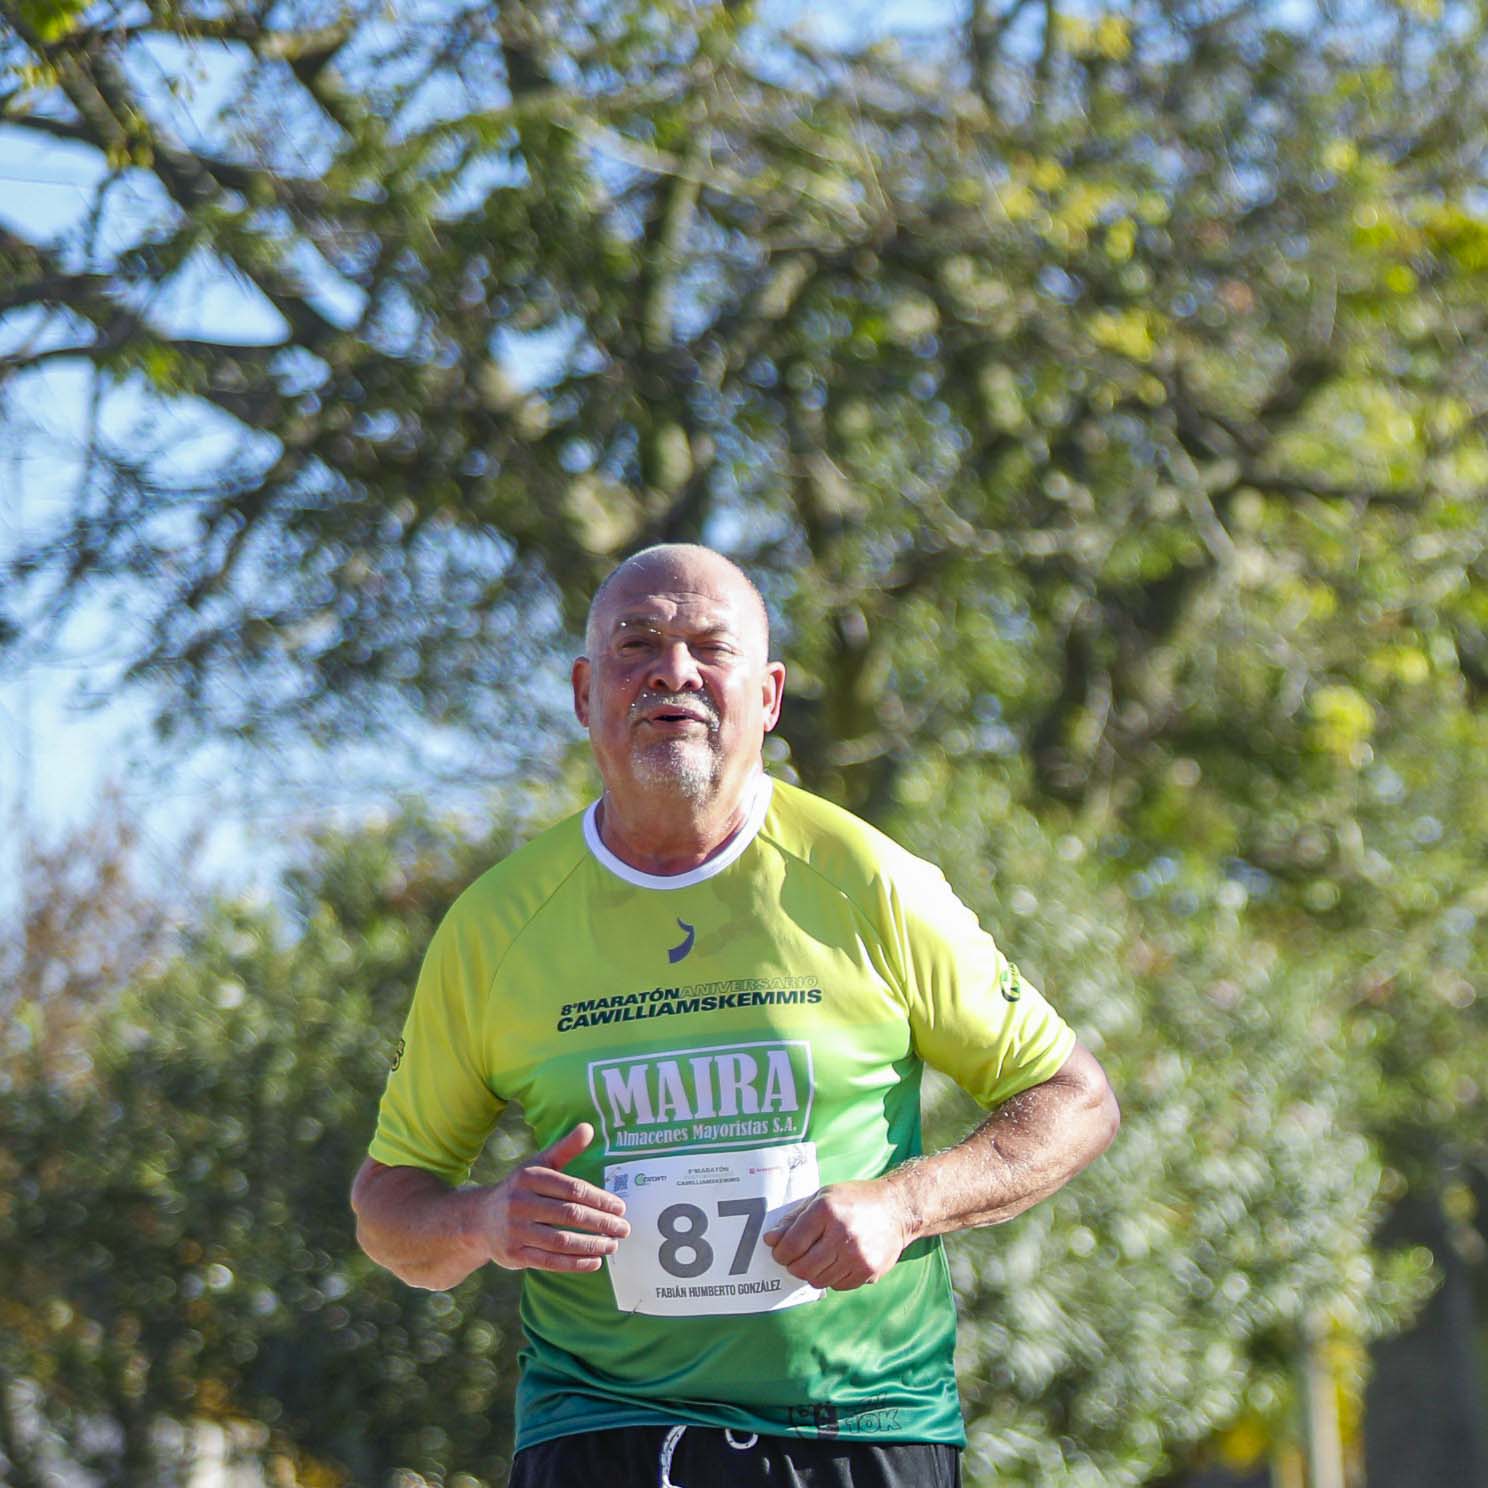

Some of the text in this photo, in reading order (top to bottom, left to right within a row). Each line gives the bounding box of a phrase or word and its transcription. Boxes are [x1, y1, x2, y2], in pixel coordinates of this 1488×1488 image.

[680, 975, 819, 999] ANIVERSARIO
[556, 988, 823, 1033] CAWILLIAMSKEMMIS
[601, 1049, 799, 1129] MAIRA
[615, 1116, 798, 1148] Almacenes Mayoristas S.A.
[656, 1196, 768, 1279] 87
[655, 1279, 782, 1298] FABIÁN HUMBERTO GONZÁLEZ
